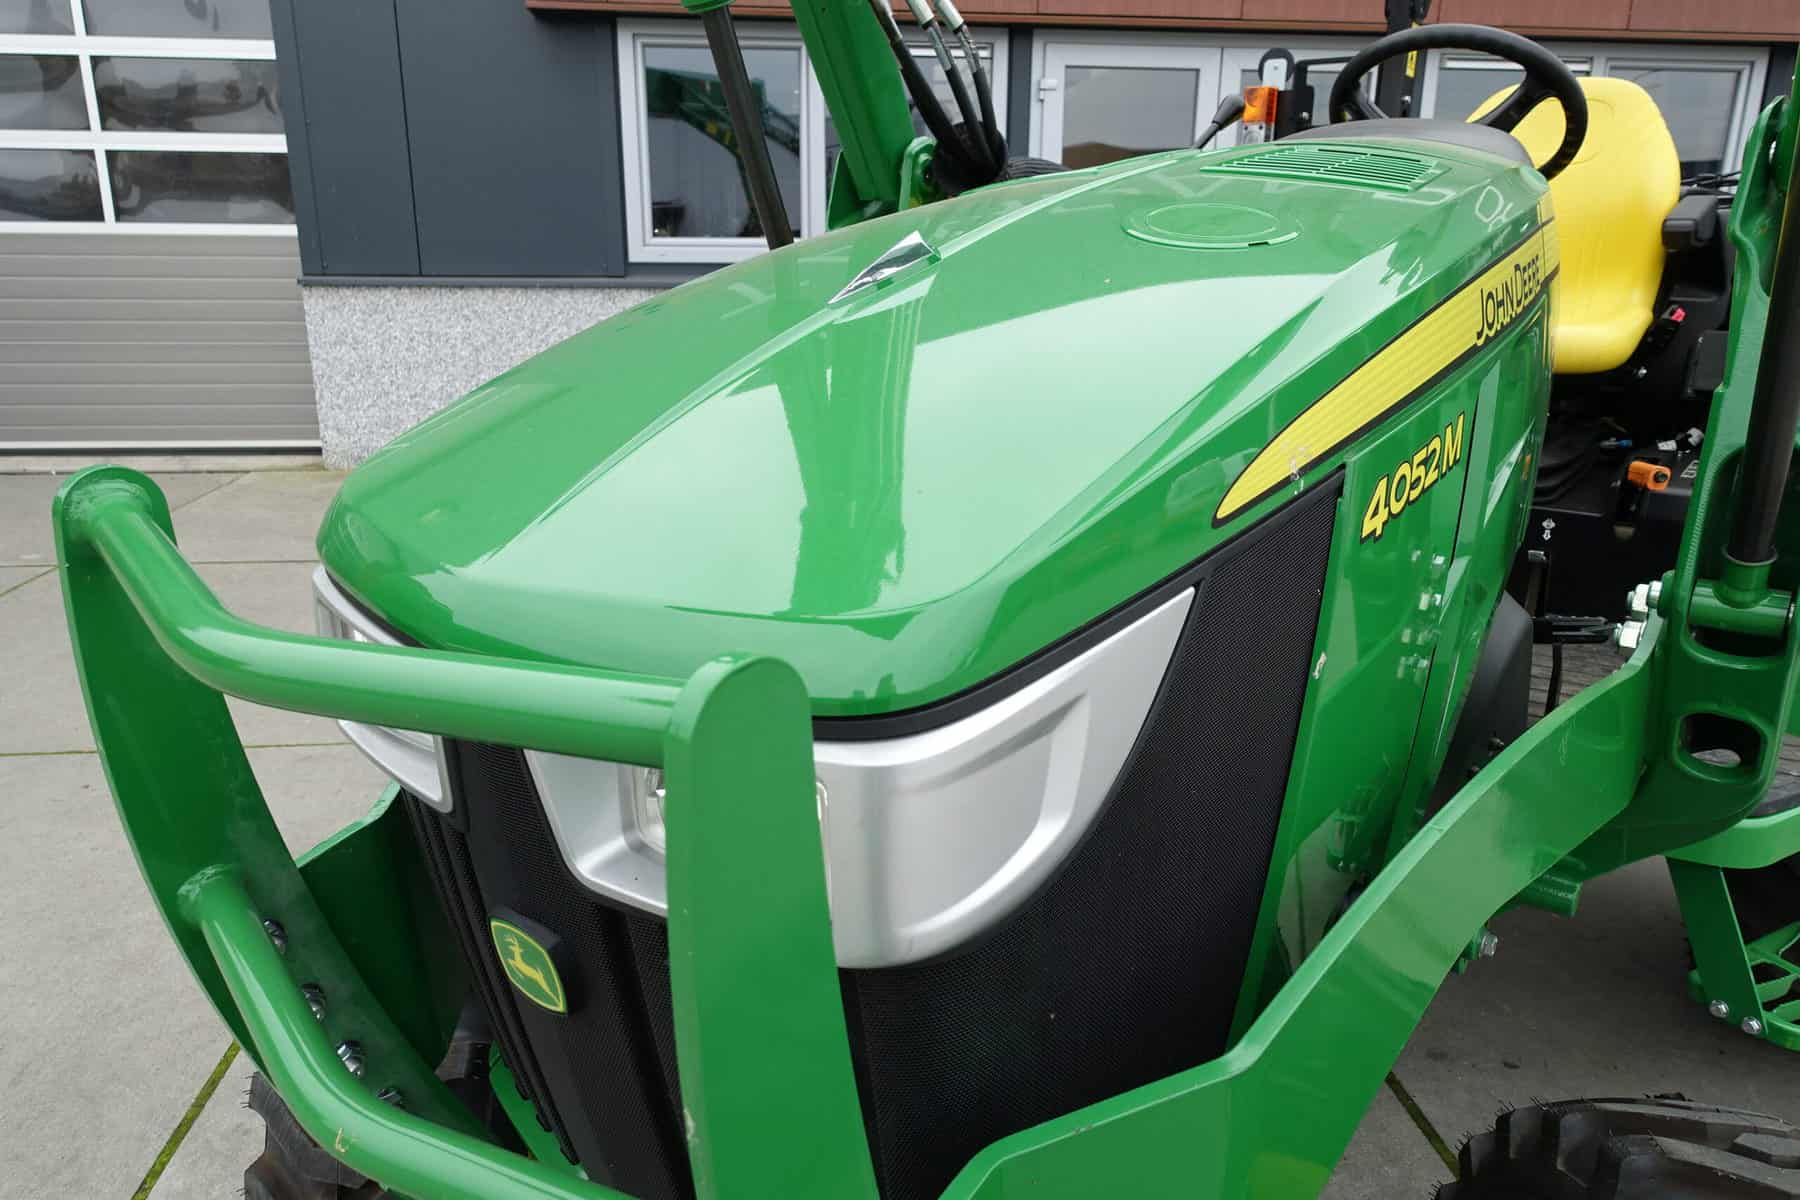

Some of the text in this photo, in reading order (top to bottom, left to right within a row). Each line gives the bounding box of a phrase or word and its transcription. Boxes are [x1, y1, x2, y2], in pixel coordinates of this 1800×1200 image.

[1476, 254, 1540, 341] JOHN DEERE
[1360, 410, 1465, 544] 4052M
